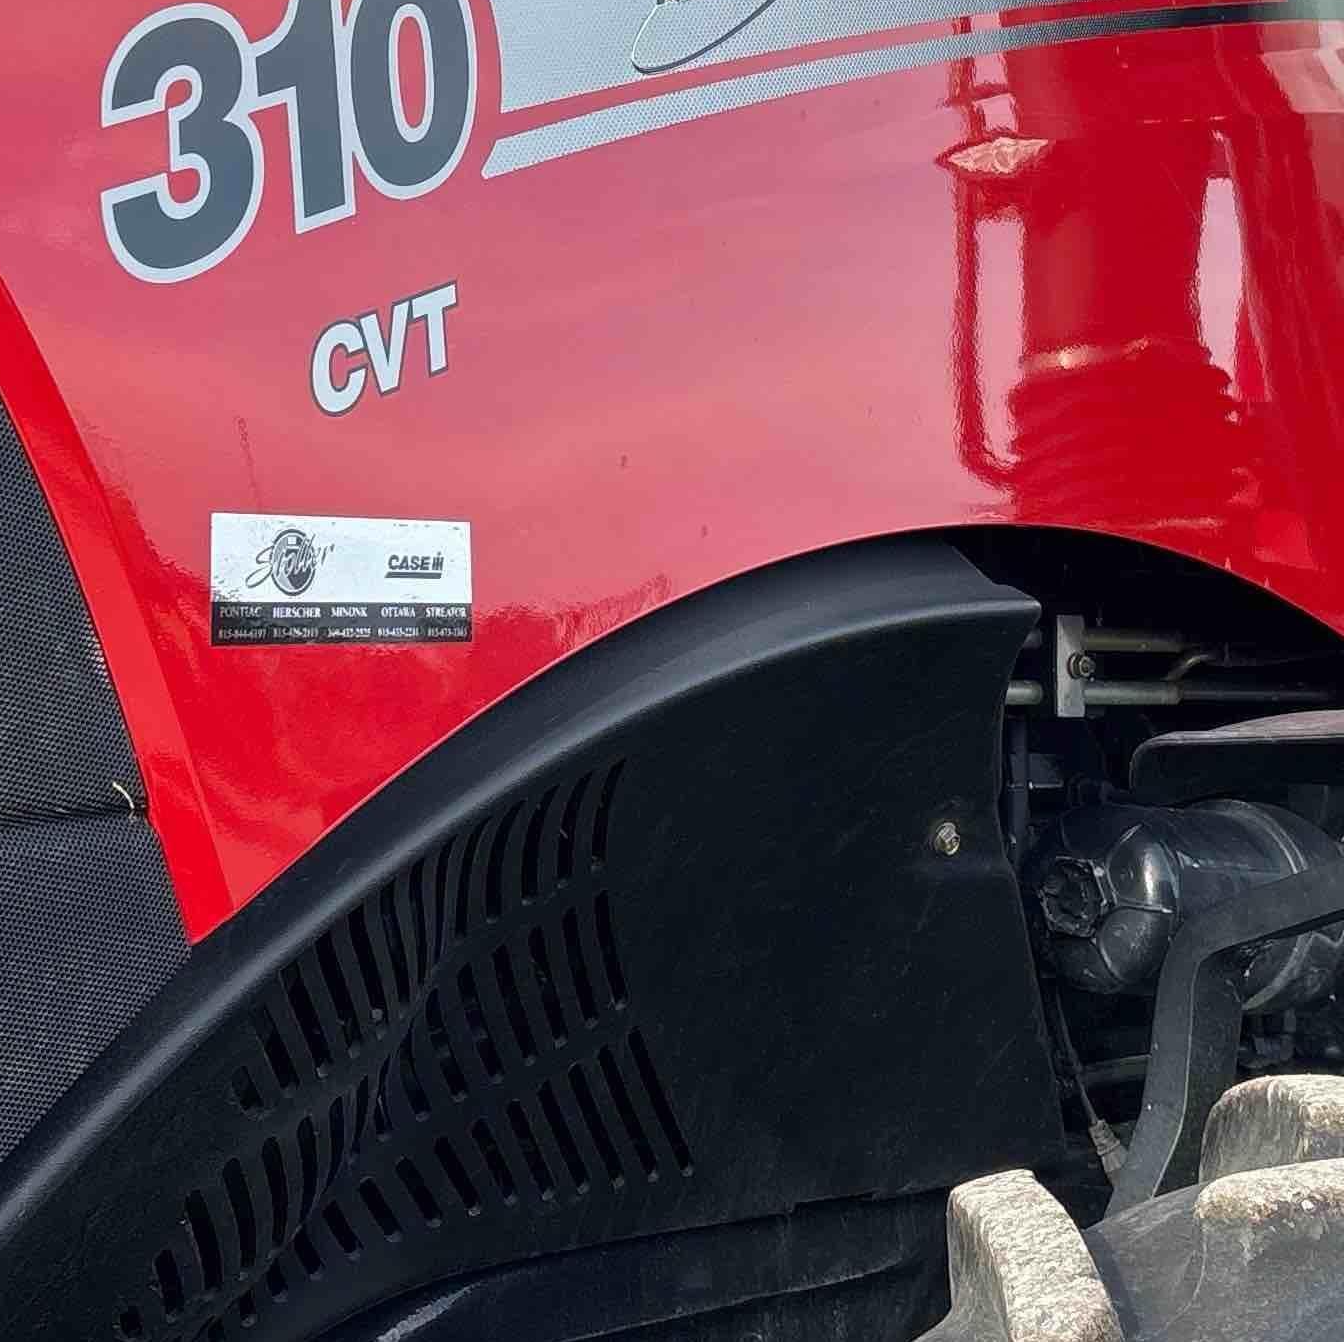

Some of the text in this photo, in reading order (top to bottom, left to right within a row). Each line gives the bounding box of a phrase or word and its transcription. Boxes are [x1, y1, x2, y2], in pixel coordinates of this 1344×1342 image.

[309, 281, 457, 418] CVT
[388, 554, 430, 572] CASE
[220, 606, 263, 618] PONTIAC
[272, 606, 321, 619] HERSCHER
[380, 606, 416, 618] OTTAWA
[425, 606, 467, 619] STREATOR
